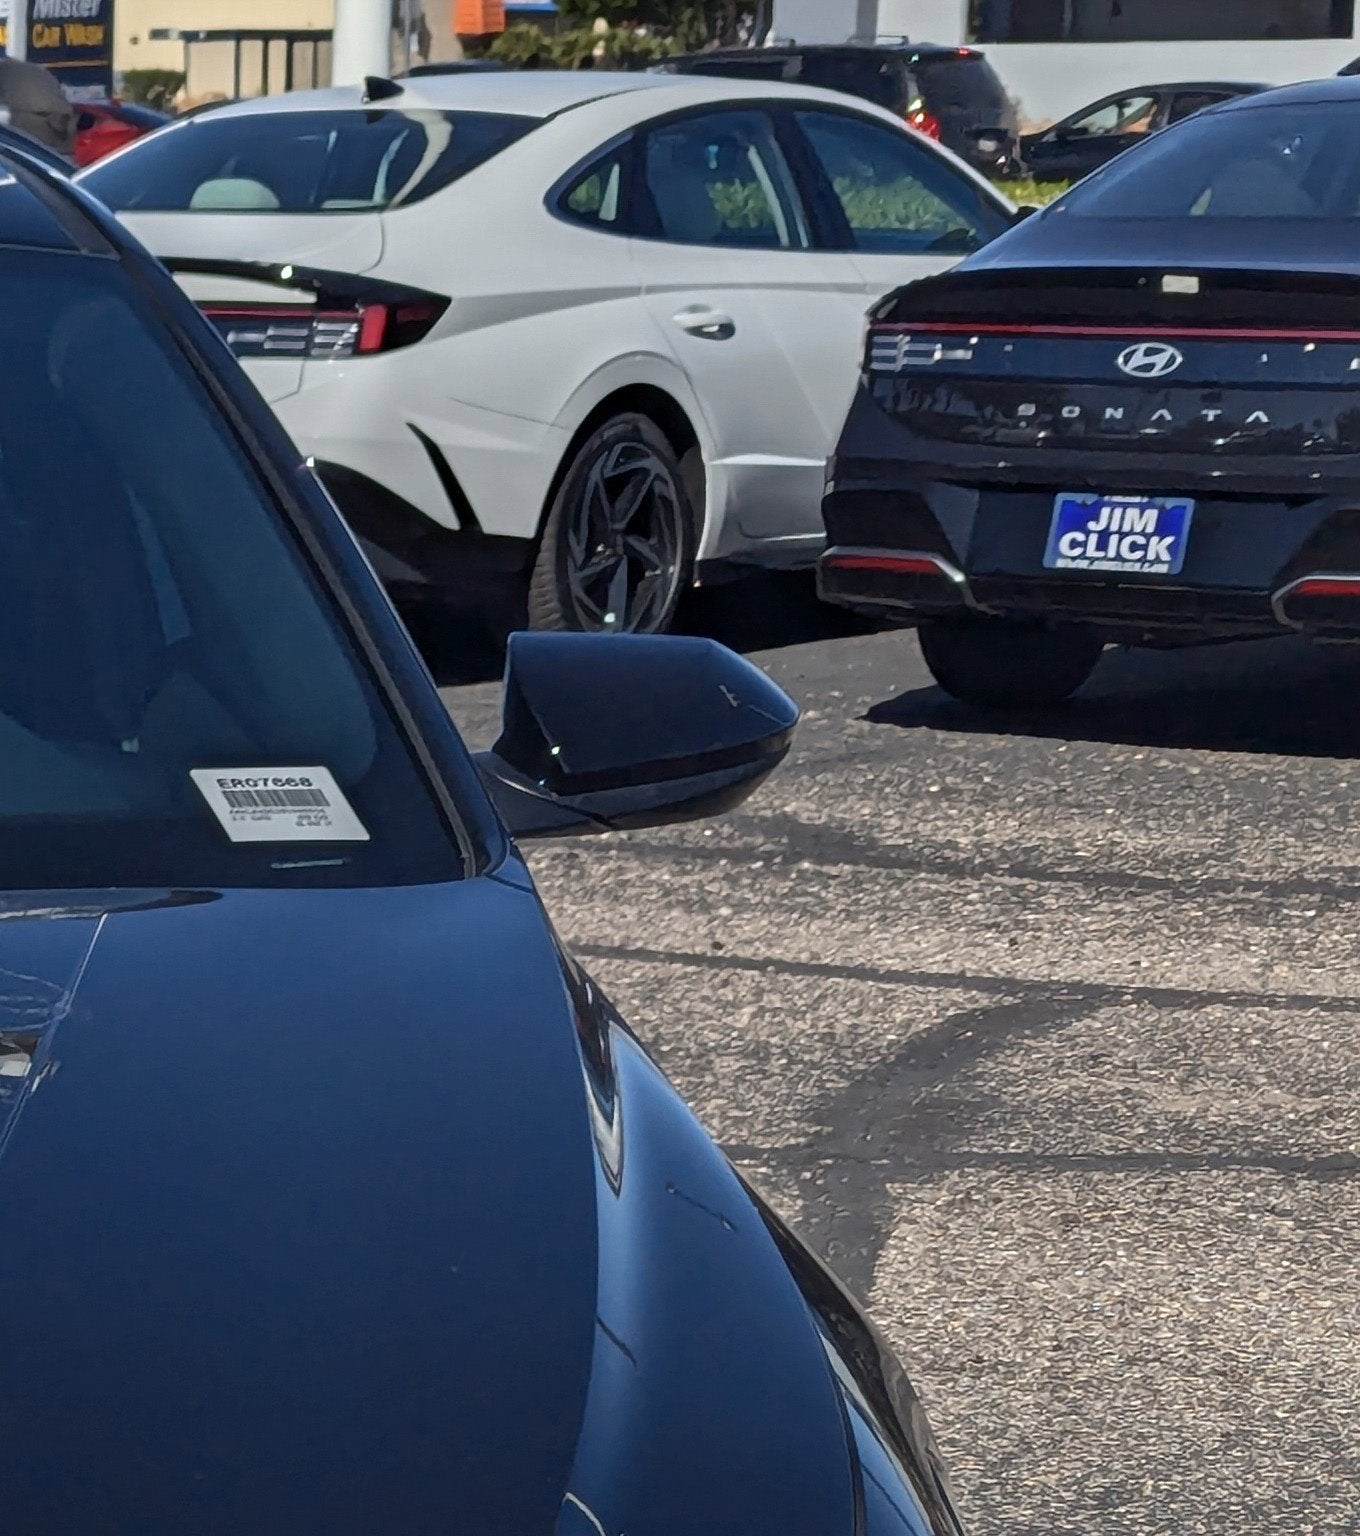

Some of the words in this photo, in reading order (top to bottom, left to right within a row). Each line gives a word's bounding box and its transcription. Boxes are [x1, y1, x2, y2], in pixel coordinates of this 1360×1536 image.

[1017, 402, 1270, 424] SONATA
[1086, 506, 1159, 533] JIM
[1058, 531, 1176, 561] CLICK
